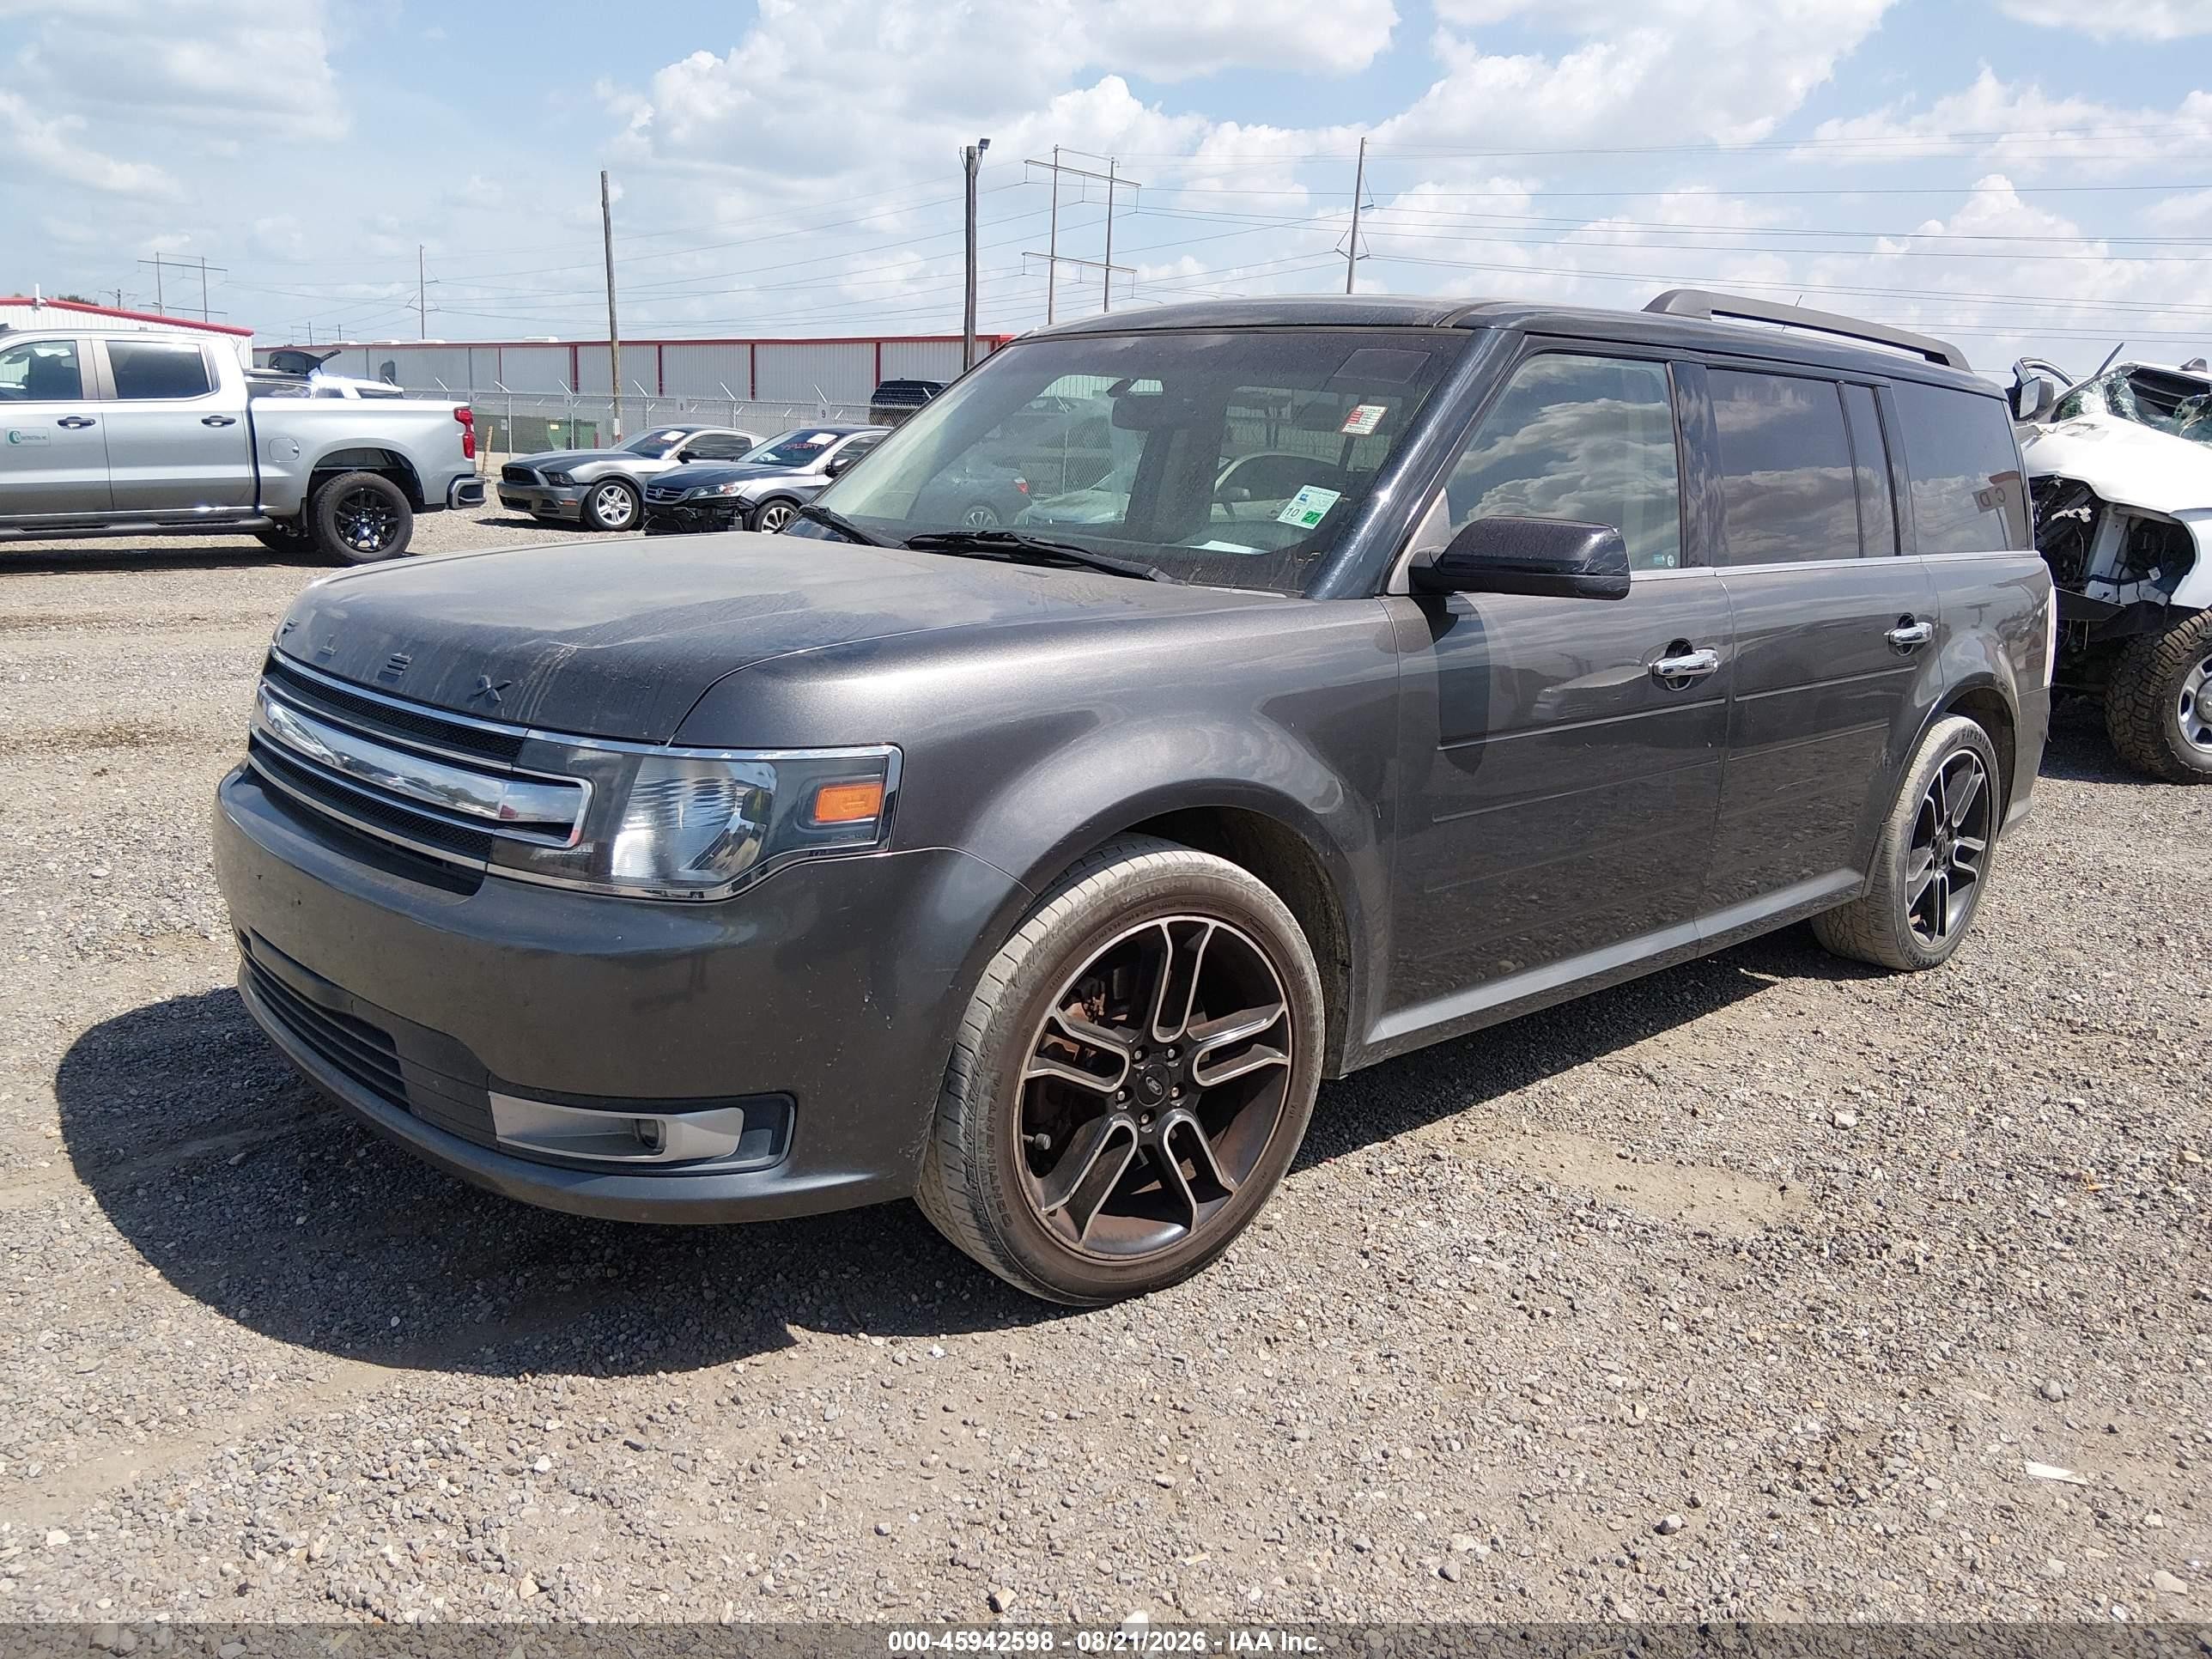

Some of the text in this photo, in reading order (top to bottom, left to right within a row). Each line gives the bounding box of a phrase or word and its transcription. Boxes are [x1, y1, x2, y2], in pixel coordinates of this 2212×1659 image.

[822, 410, 826, 418] 9
[1285, 507, 1321, 523] 10 27
